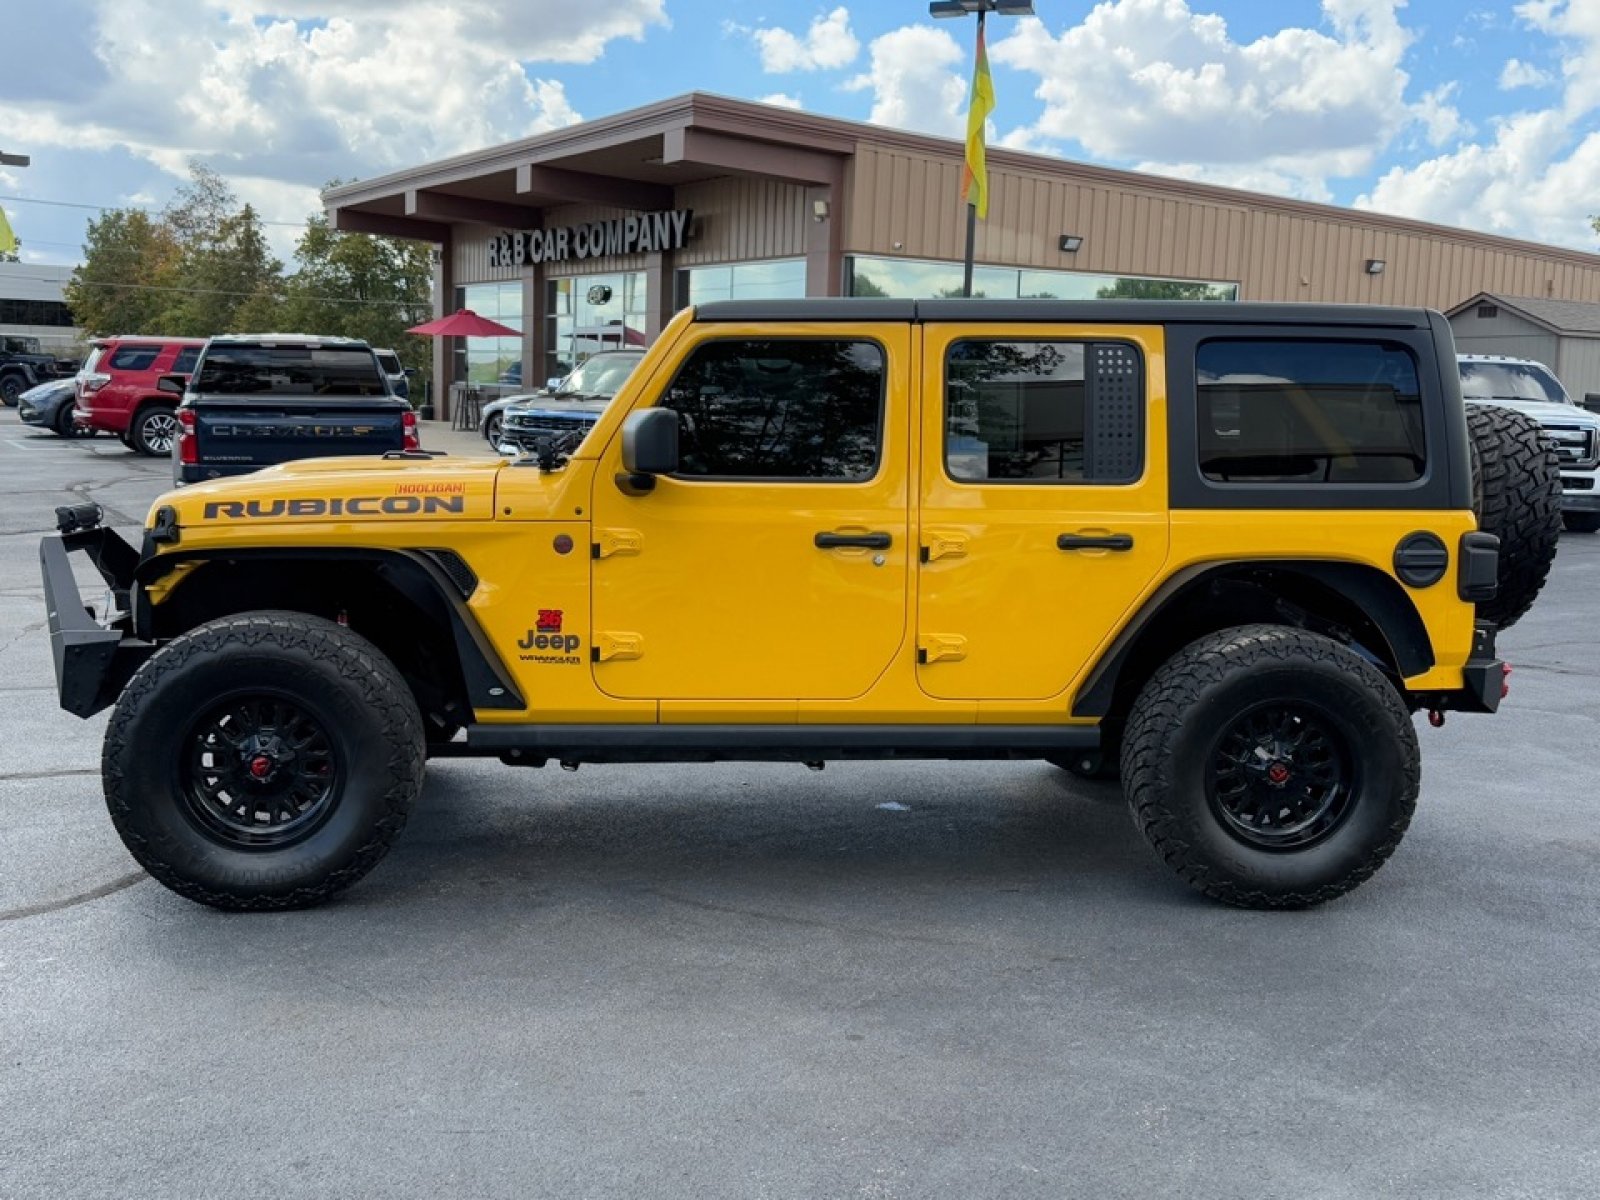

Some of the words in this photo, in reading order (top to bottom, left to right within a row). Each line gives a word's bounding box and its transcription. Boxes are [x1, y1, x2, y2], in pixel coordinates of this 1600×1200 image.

[488, 231, 526, 267] R&B
[531, 226, 570, 264] CAR
[575, 208, 690, 259] COMPANY
[203, 495, 464, 519] RUBICON
[518, 630, 580, 654] Jeep
